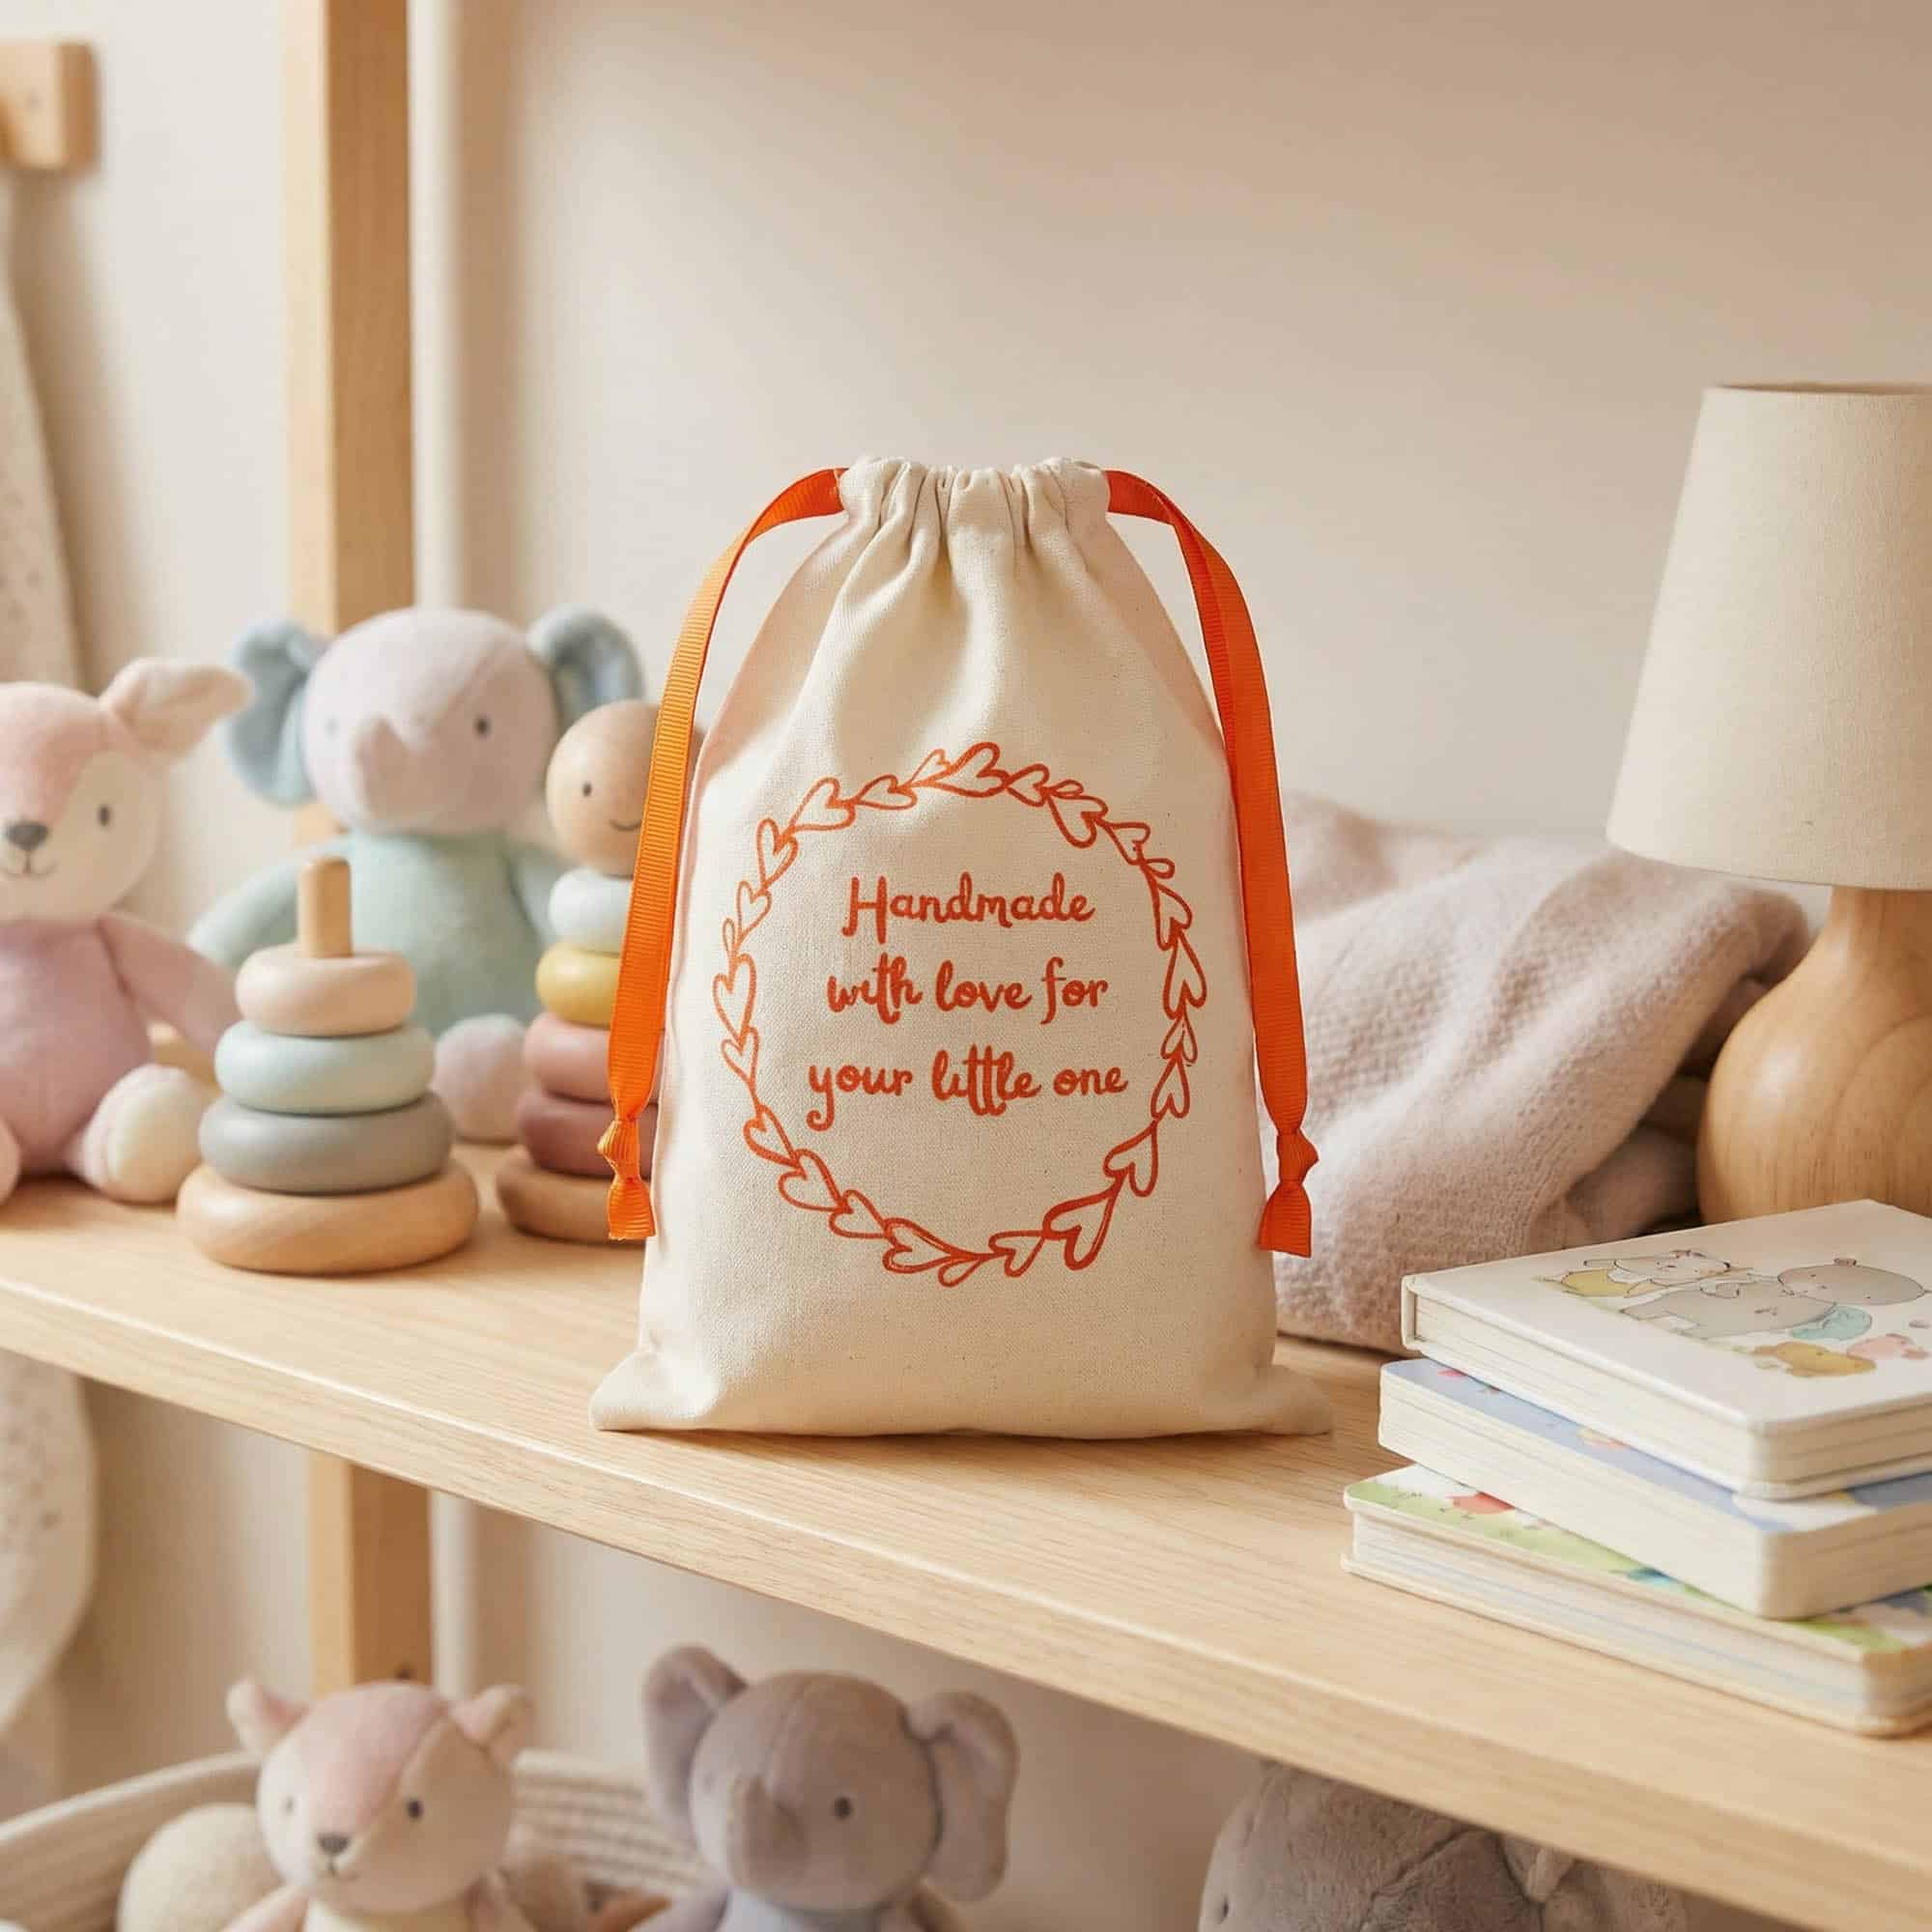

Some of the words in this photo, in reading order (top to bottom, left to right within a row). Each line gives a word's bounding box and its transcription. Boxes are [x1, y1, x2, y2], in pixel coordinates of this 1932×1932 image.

[841, 870, 1096, 946] Handmade
[826, 952, 923, 1025] with
[934, 959, 1033, 1013] love
[1039, 955, 1109, 1026] for
[806, 1064, 913, 1132] your
[930, 1042, 1042, 1117] little
[1052, 1066, 1128, 1096] one
